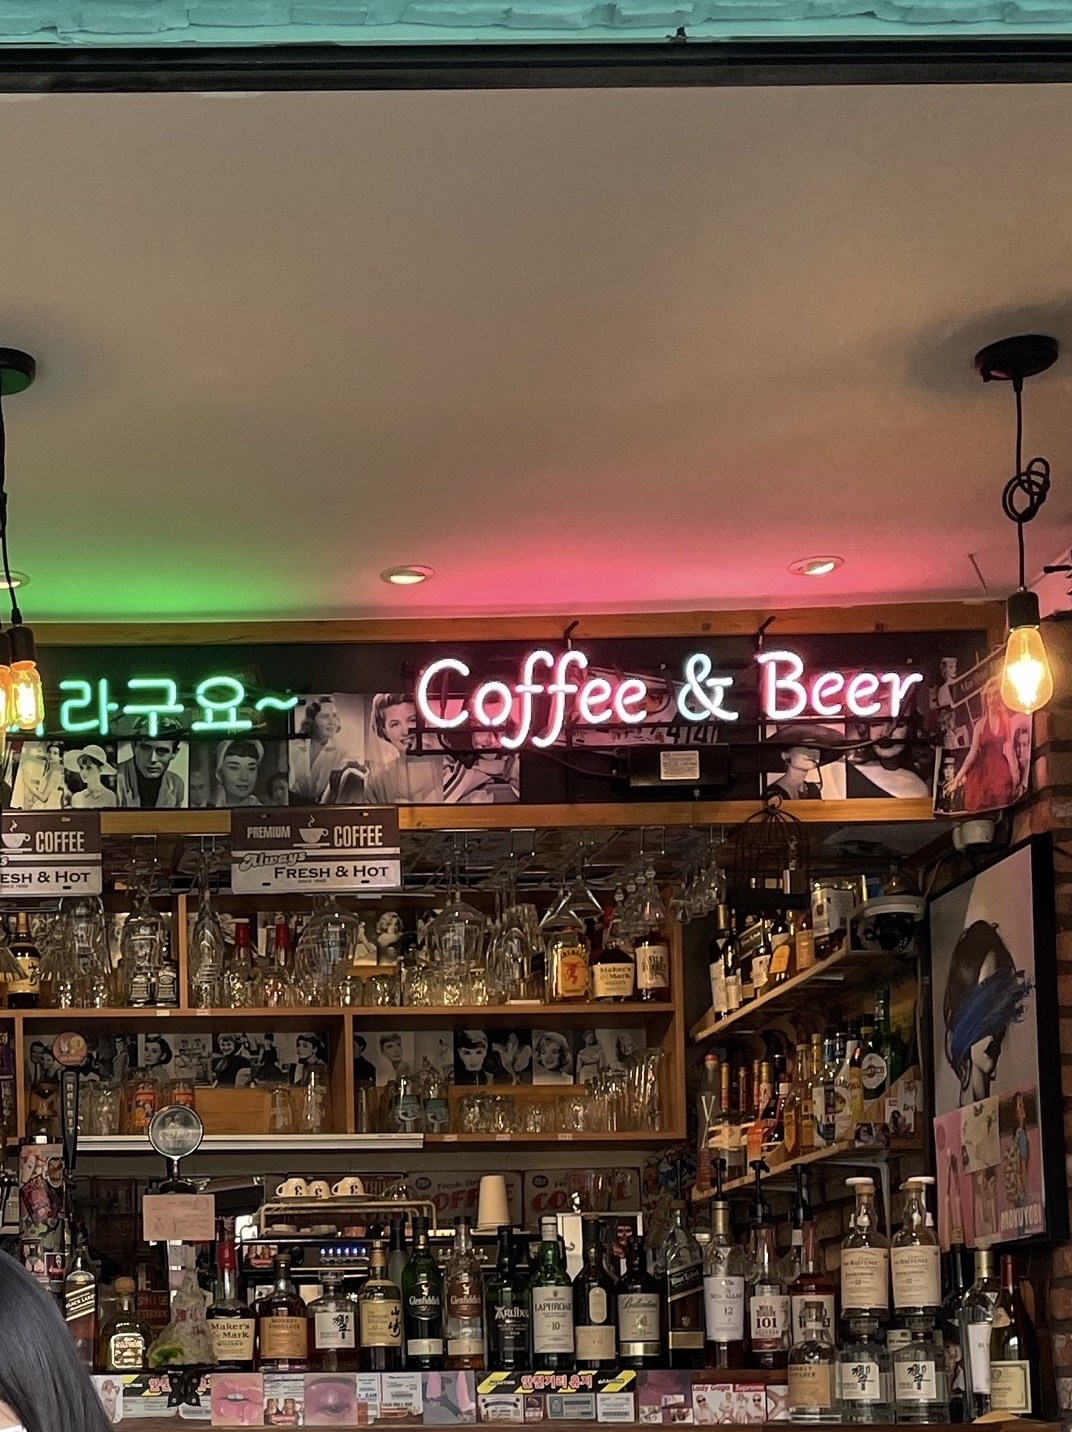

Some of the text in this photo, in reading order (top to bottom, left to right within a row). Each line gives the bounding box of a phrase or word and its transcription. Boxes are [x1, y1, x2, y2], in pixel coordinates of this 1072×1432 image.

[417, 650, 924, 748] Coffee & Beer
[8, 676, 299, 738] 라구요~
[35, 831, 85, 852] COFFEE
[247, 825, 383, 847] PREMIUM COFFEE
[239, 851, 307, 872] Always
[37, 871, 50, 883] &
[335, 866, 348, 877] &
[210, 1322, 250, 1332] Maker's
[551, 1321, 561, 1331] 10
[756, 1317, 777, 1329] 101
[222, 1331, 250, 1339] Mark
[521, 1374, 593, 1390] 안전거리 유지
